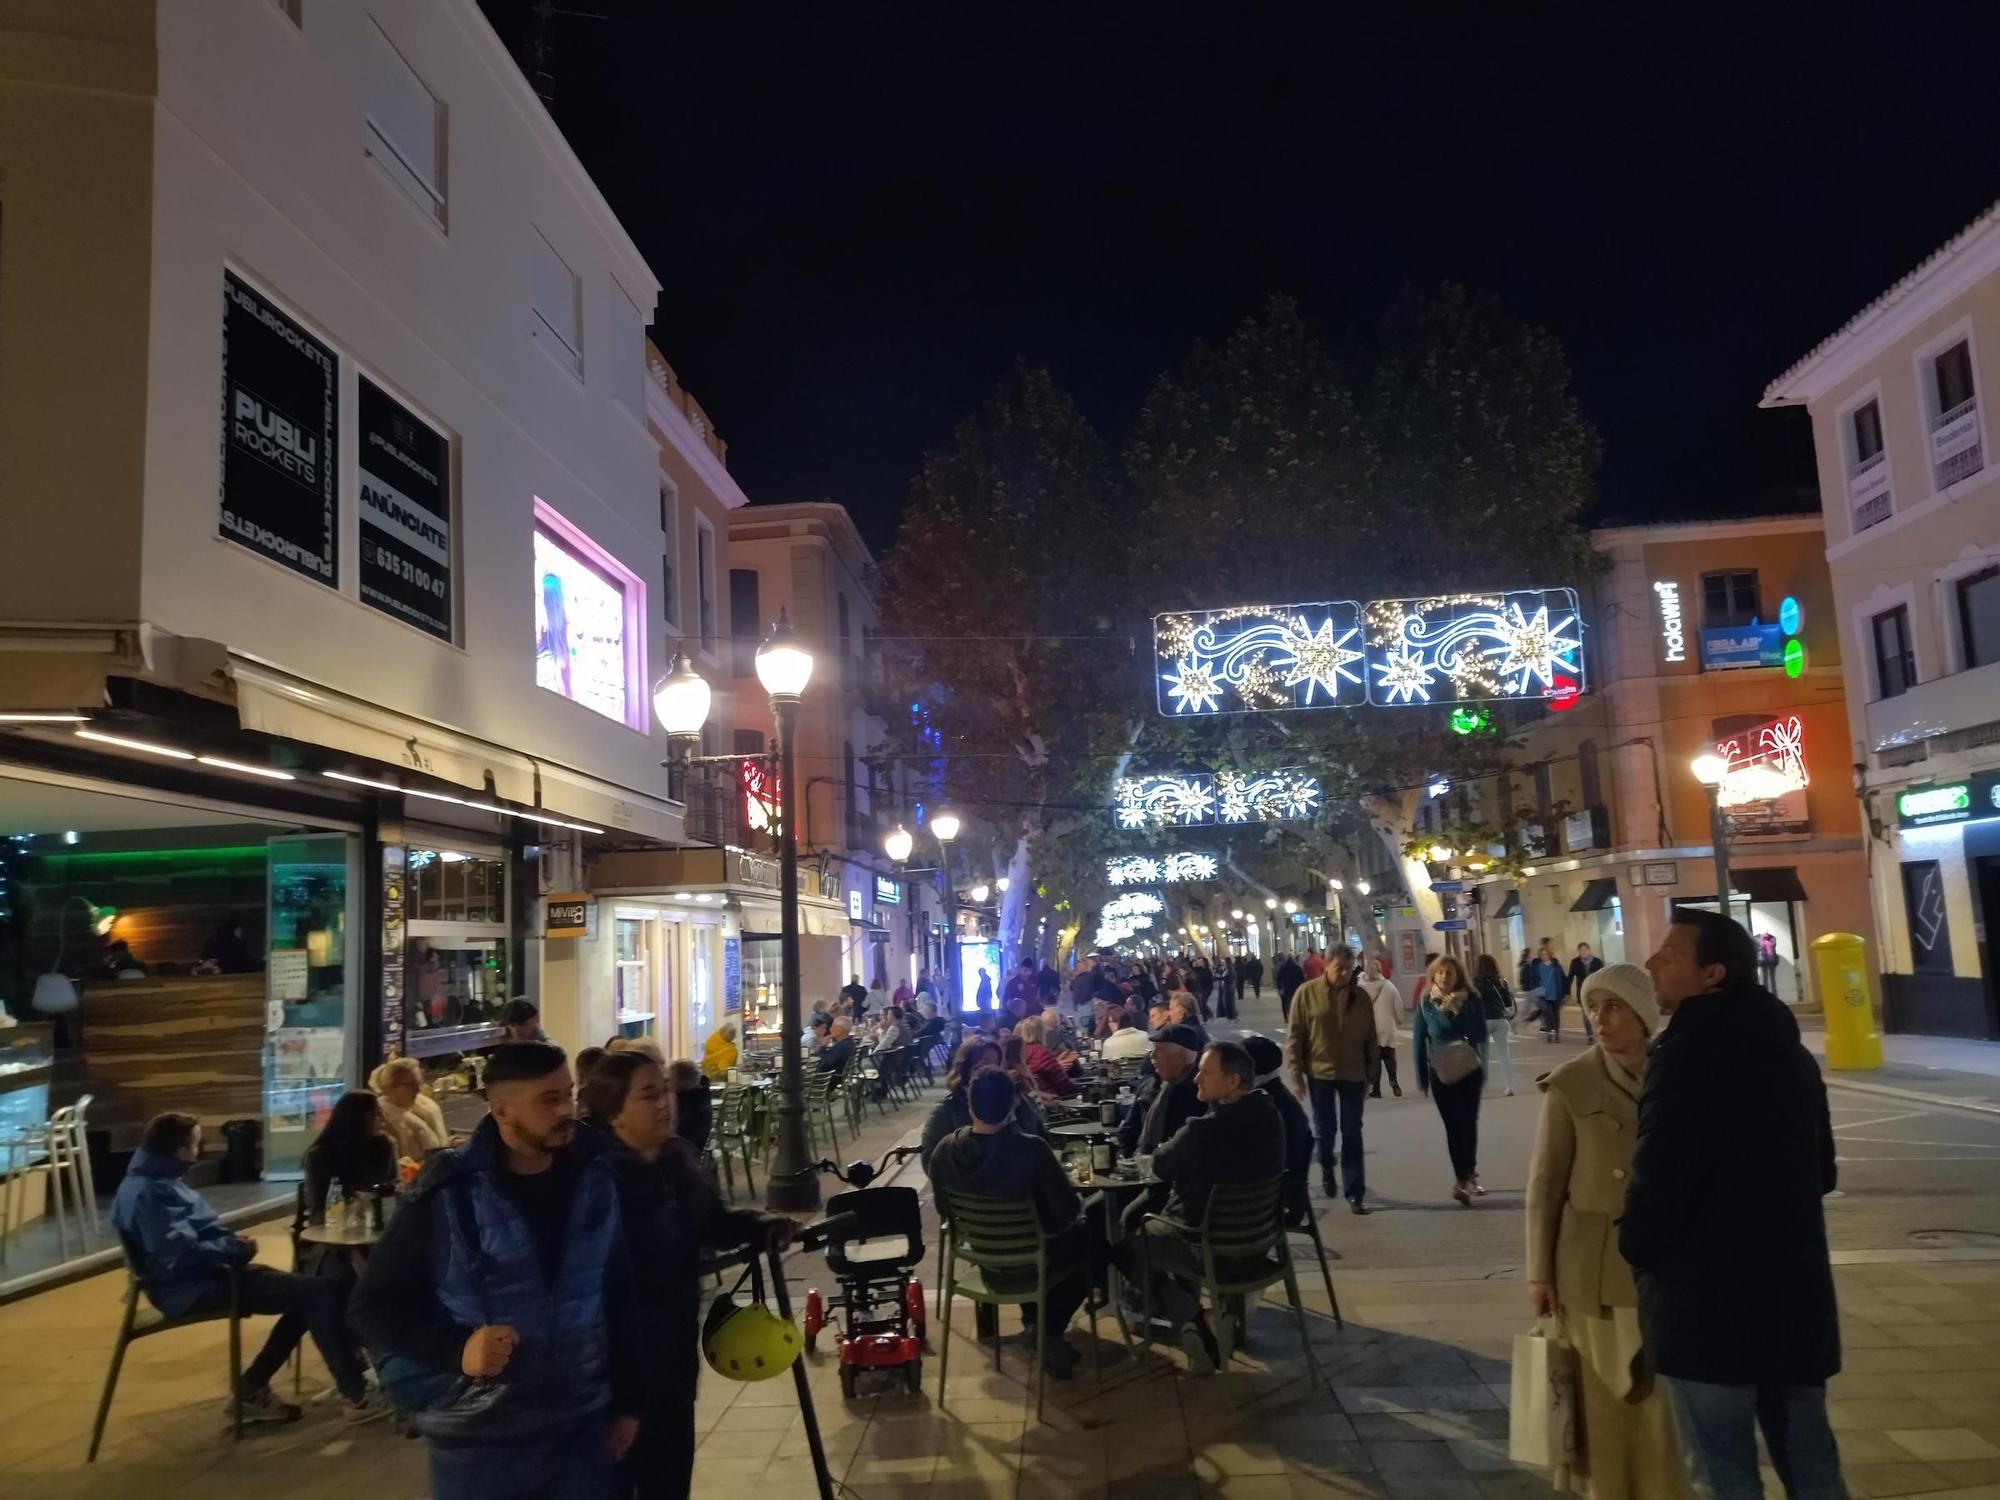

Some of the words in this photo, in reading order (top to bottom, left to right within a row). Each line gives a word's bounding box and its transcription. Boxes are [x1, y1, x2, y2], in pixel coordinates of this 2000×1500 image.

[234, 421, 316, 484] ROCKETS
[235, 388, 316, 465] PUBLI
[360, 484, 447, 551] ANÚNCIATE
[377, 546, 401, 576] 635
[401, 560, 414, 584] 31
[415, 567, 431, 592] 00
[431, 578, 445, 599] 47
